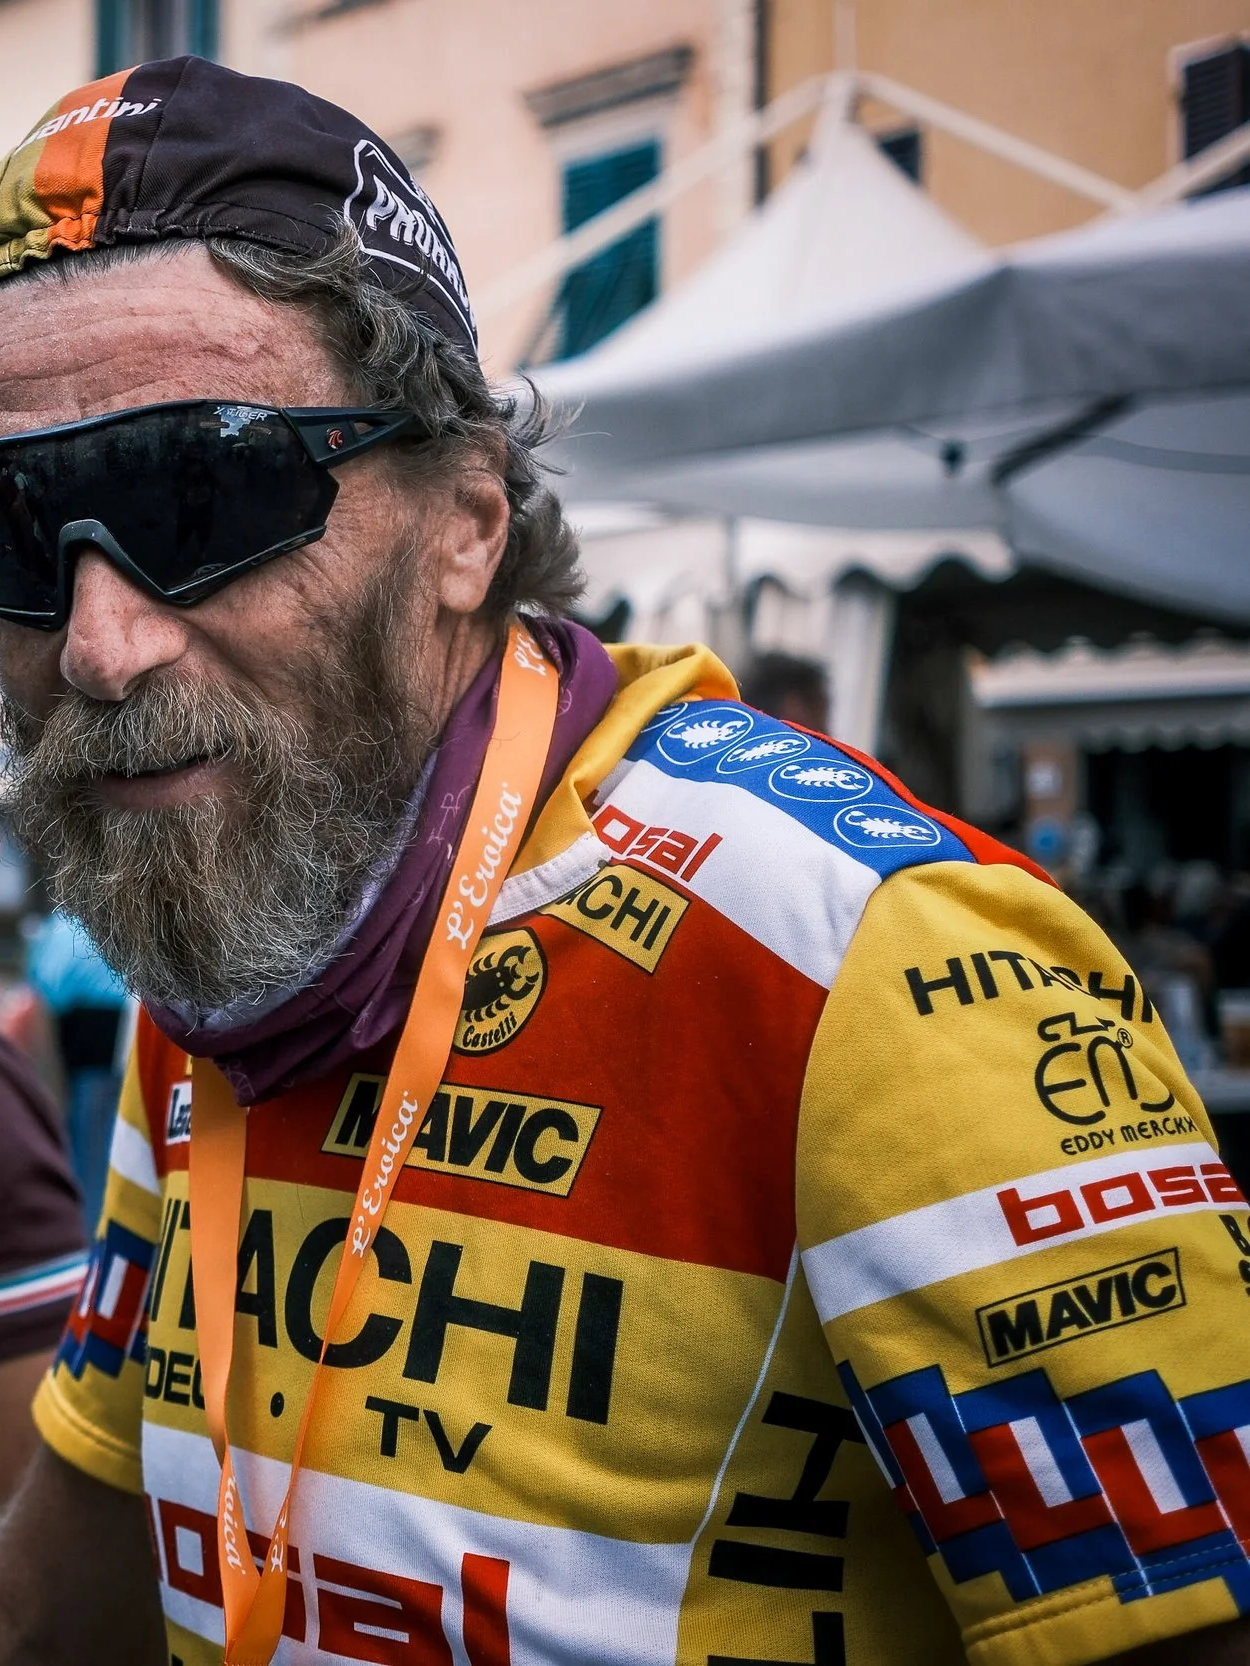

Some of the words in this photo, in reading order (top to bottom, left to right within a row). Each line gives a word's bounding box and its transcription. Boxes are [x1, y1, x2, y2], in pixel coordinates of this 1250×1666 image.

[446, 782, 523, 950] L'Eroica
[590, 804, 723, 883] osal
[555, 874, 672, 950] ACHI
[462, 1011, 519, 1048] Castelli
[335, 1080, 580, 1184] MAVIC
[351, 1090, 418, 1258] L'Eroica
[1060, 1128, 1116, 1156] EDDY
[1121, 1115, 1199, 1143] MERCKX
[996, 1162, 1248, 1247] bosa
[151, 1198, 624, 1425] ITACHI
[987, 1262, 1178, 1359] MAVIC
[365, 1396, 493, 1474] TV
[222, 1476, 247, 1575] roica
[145, 1497, 511, 1666] oal
